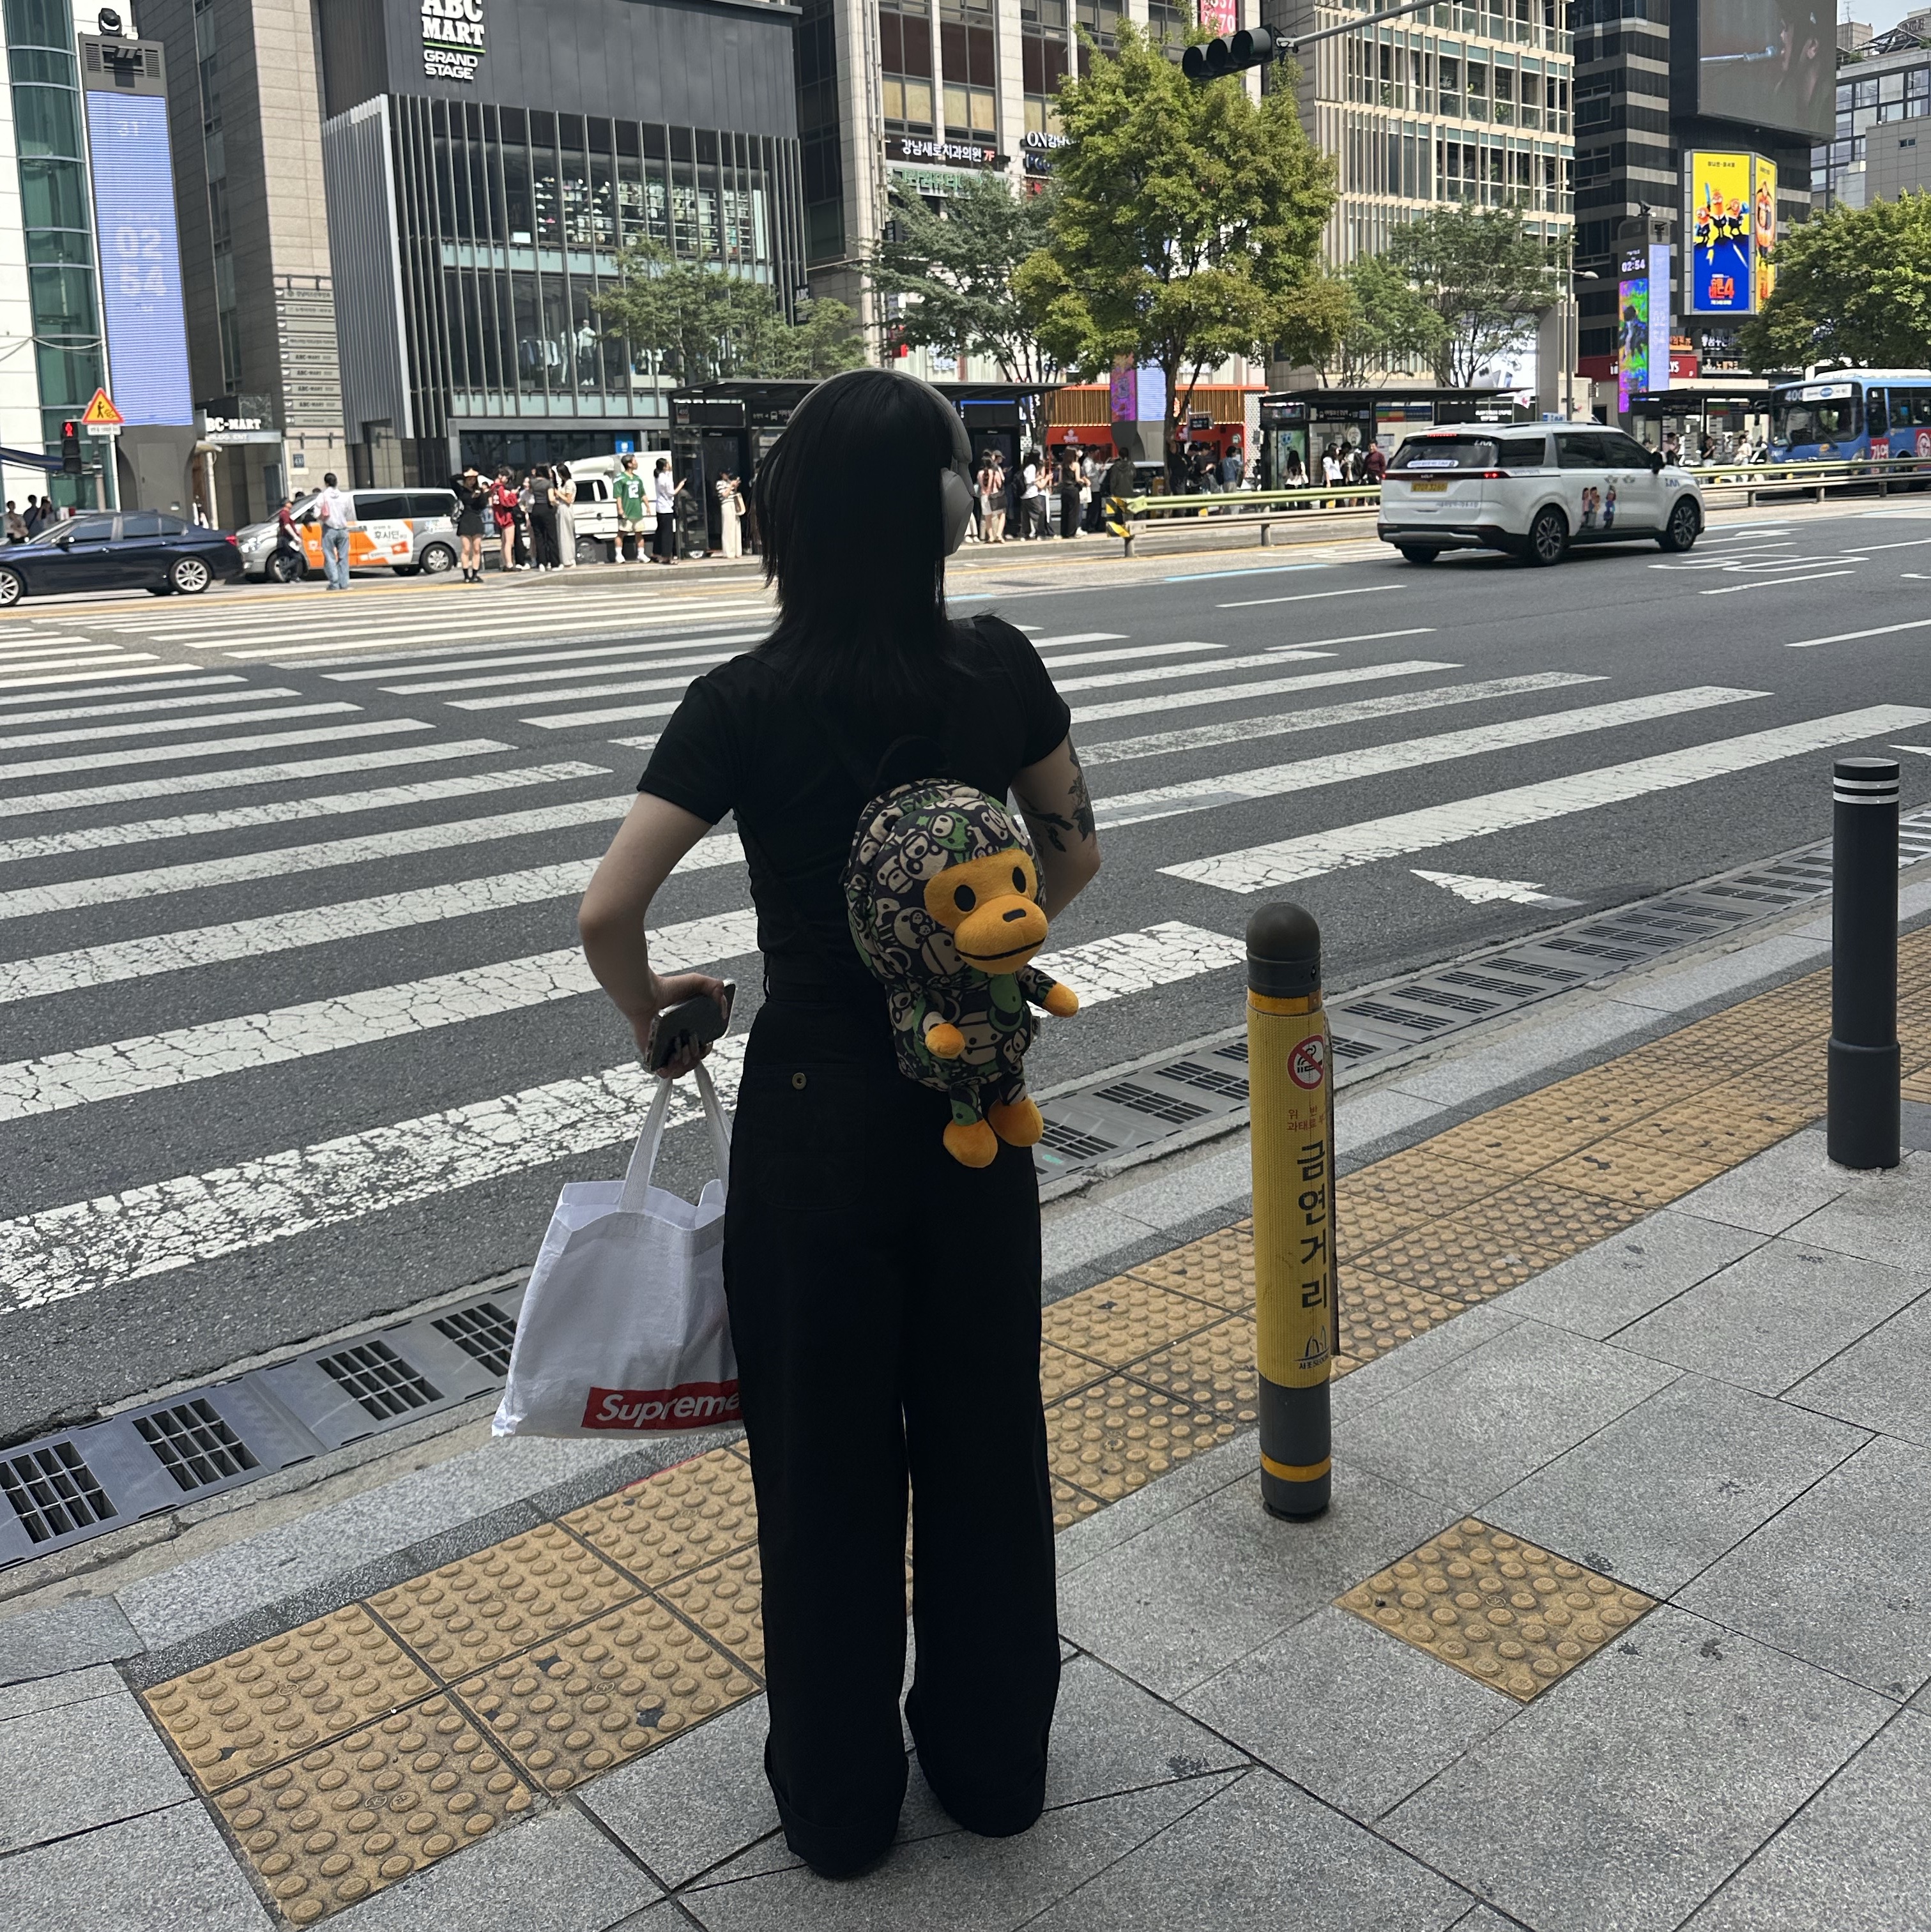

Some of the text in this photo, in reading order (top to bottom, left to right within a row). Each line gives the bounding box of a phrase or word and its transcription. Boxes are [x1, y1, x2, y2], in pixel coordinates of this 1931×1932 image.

[422, 0, 484, 22] ABC
[422, 16, 485, 45] MART
[424, 49, 478, 68] GRAND
[424, 63, 474, 80] STAGE
[901, 139, 982, 162] 강남새로치과의원
[116, 226, 161, 257] 02
[1621, 259, 1645, 272] 02:54
[206, 417, 261, 432] BC-MART
[1297, 1139, 1327, 1309] 금연거리
[596, 1392, 740, 1428] Supreme
